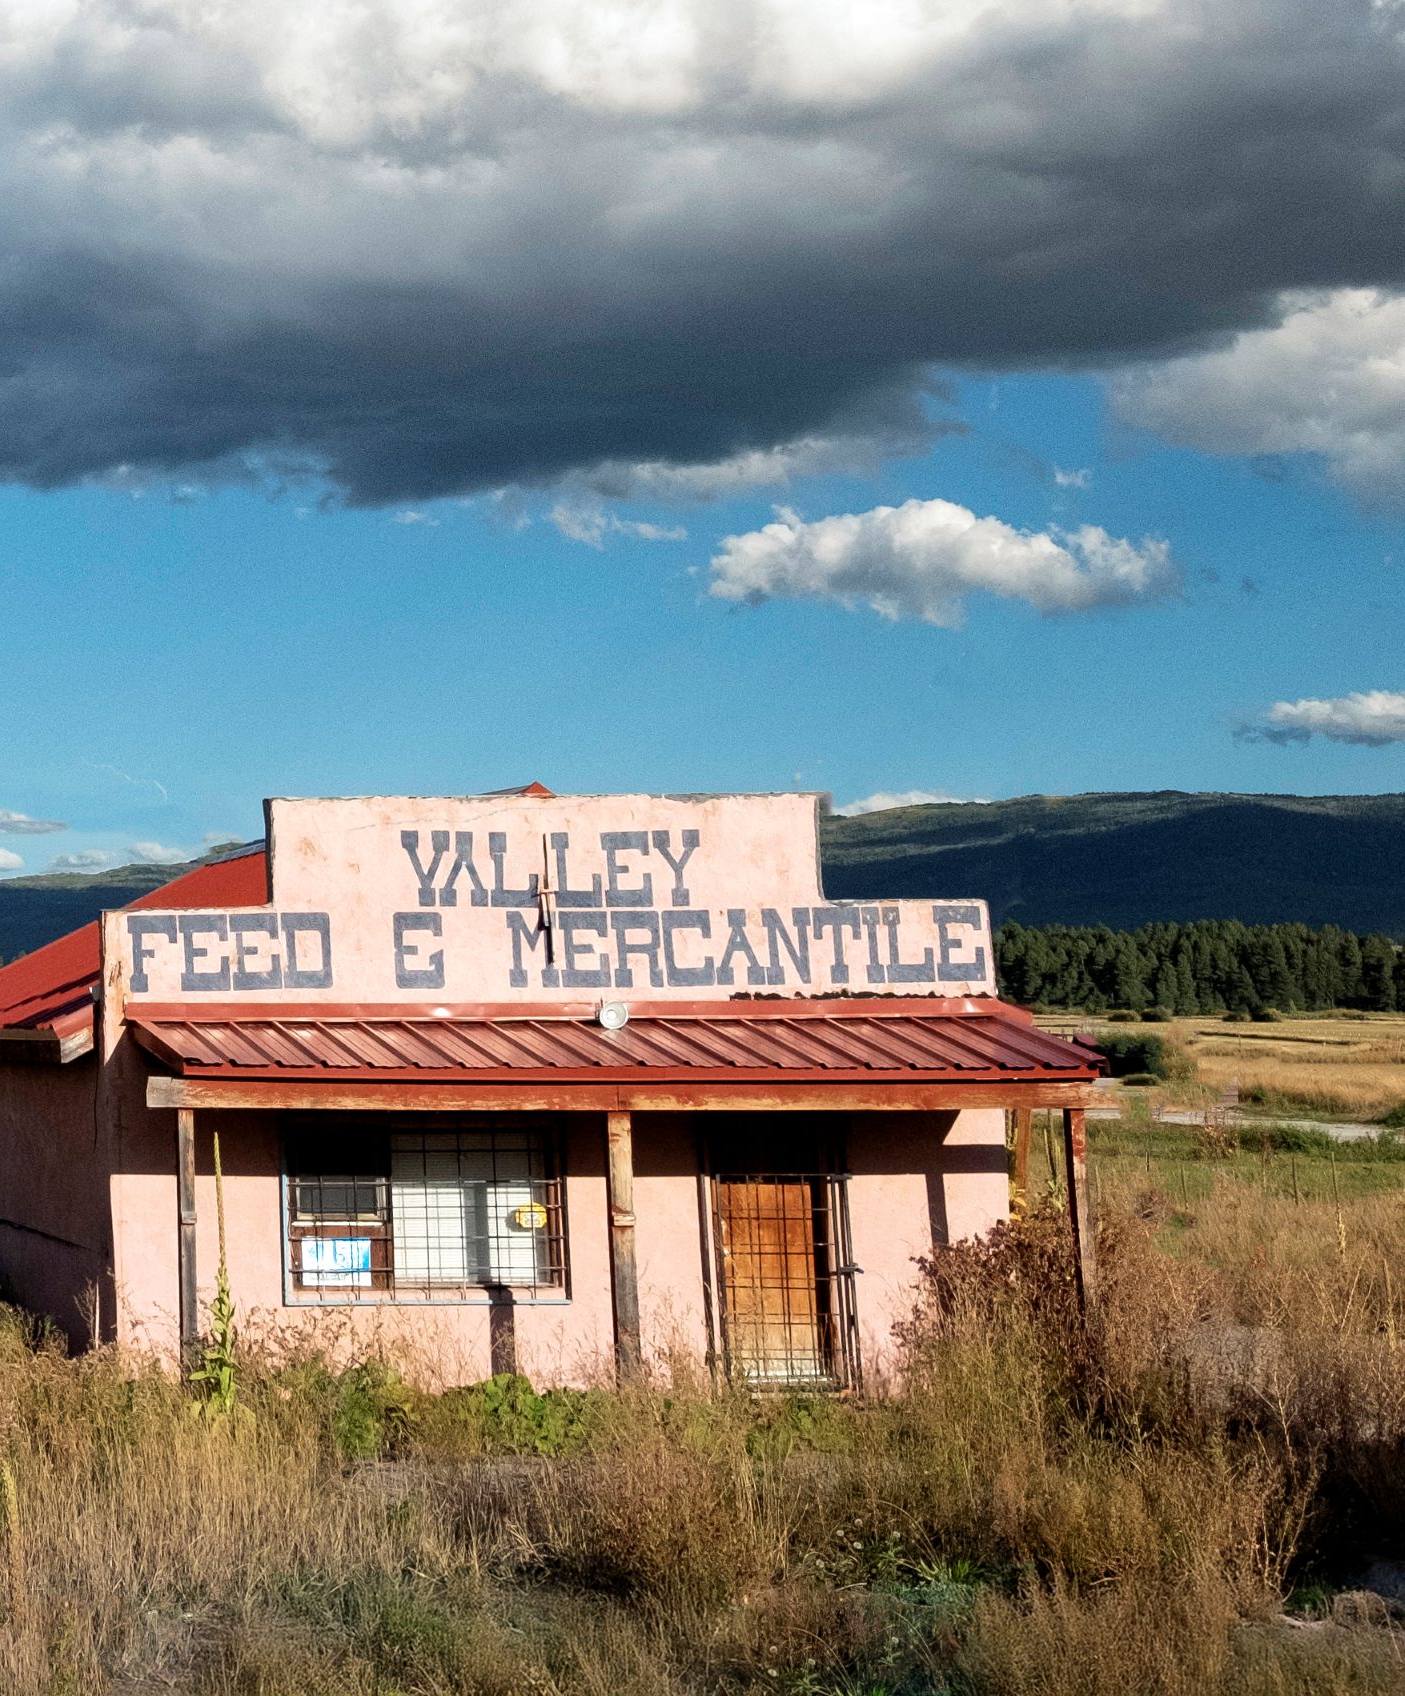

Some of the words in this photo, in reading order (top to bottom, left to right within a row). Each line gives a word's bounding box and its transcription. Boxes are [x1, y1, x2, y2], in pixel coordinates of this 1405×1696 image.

[400, 829, 700, 908] VALLEY
[127, 911, 333, 993] FEED
[506, 905, 986, 988] MERCANTILE
